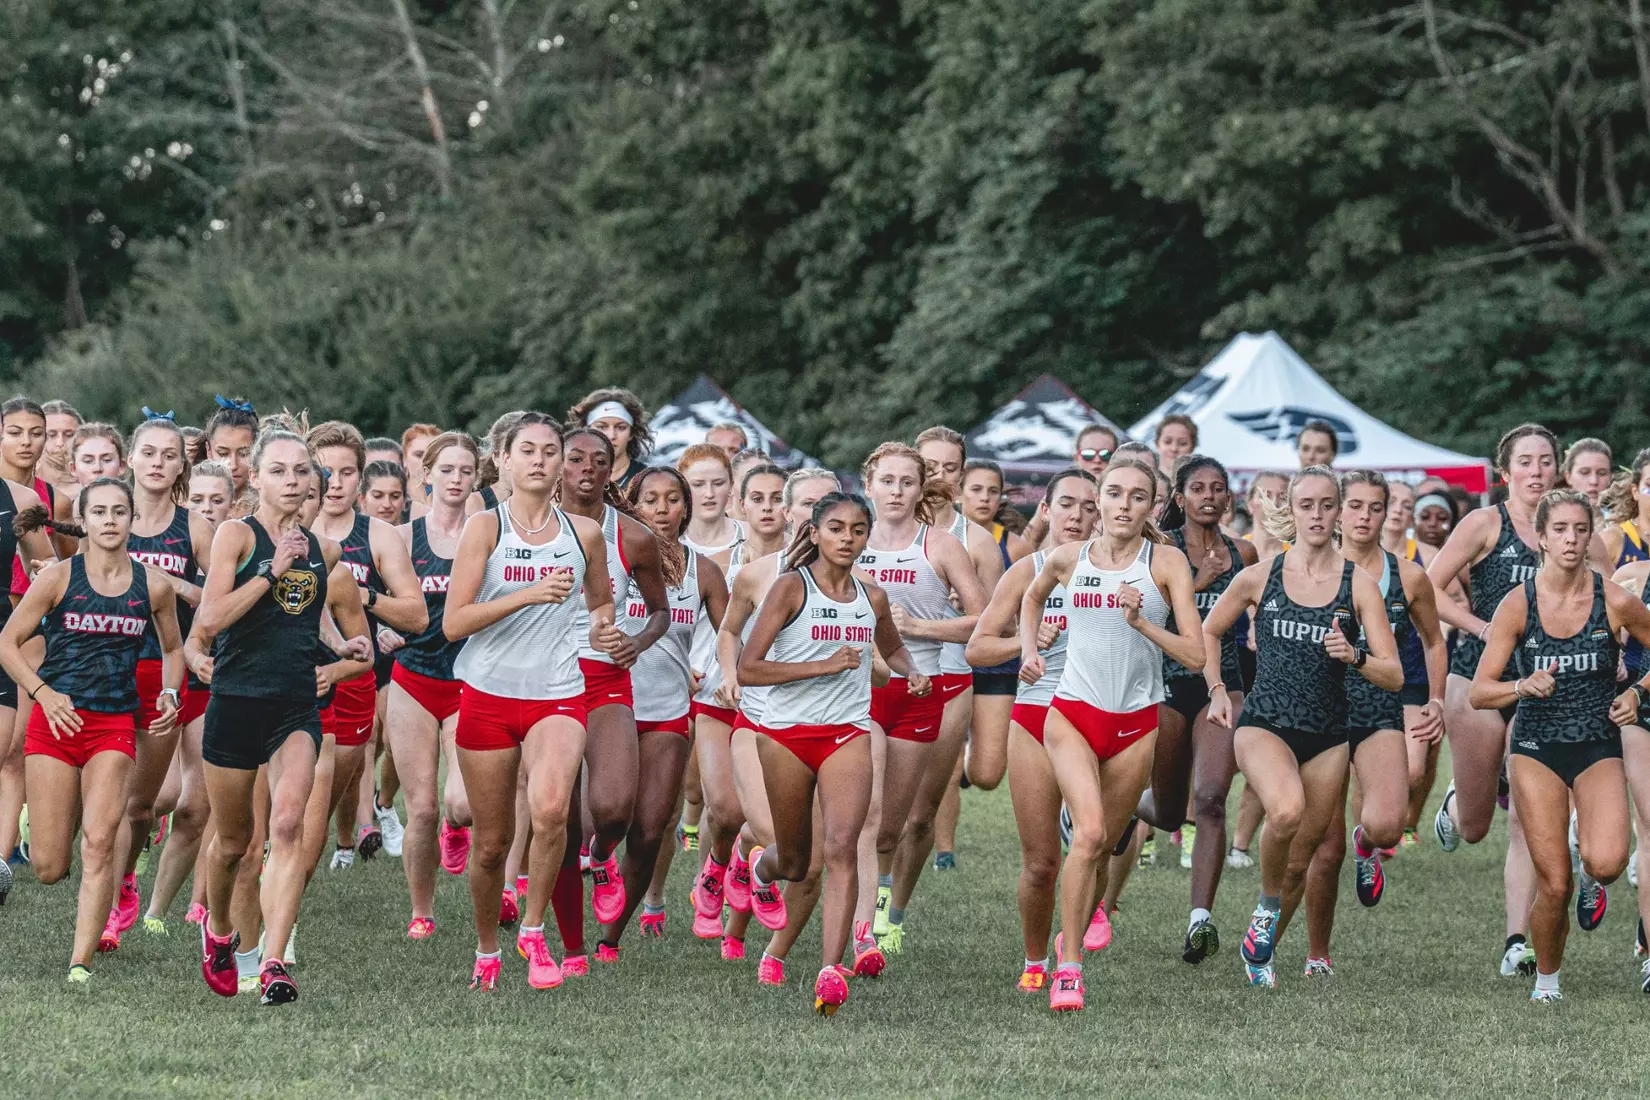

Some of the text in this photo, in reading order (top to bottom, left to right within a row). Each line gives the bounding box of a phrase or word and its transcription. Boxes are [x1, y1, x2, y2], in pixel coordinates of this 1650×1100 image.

[504, 565, 535, 582] OHIO
[880, 569, 917, 585] STATE
[1073, 592, 1102, 608] OHIO
[64, 612, 147, 636] DAYTON
[671, 608, 694, 624] TATE
[811, 624, 872, 643] OHIO STATE
